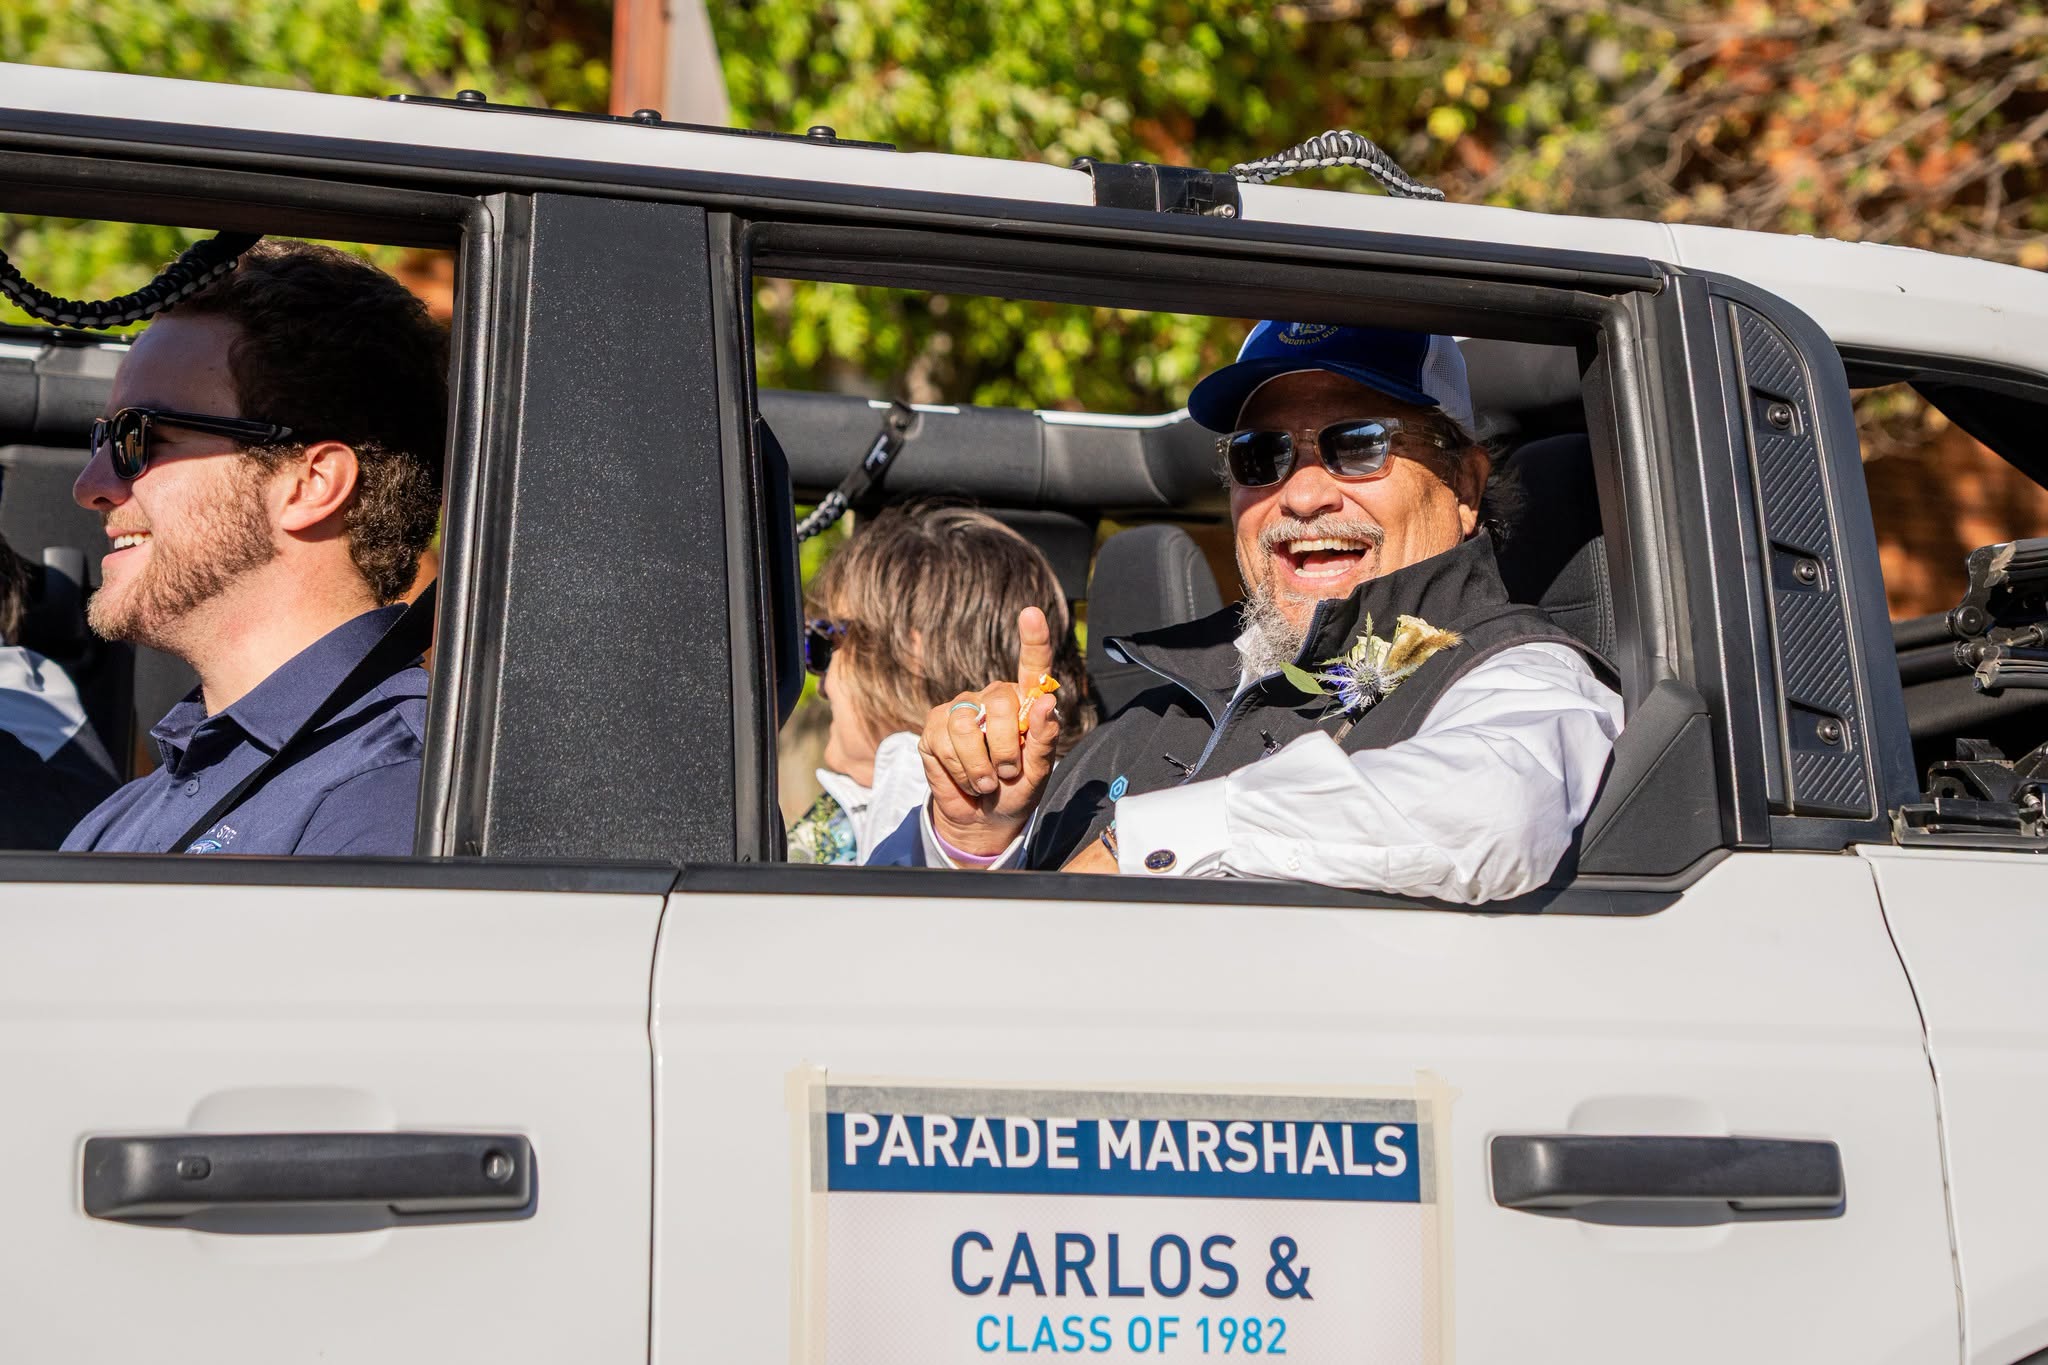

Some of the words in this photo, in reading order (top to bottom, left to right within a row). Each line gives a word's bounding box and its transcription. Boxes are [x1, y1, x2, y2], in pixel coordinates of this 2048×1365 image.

[844, 1112, 1079, 1169] PARADE
[1098, 1118, 1408, 1177] MARSHALS
[951, 1230, 1240, 1299] CARLOS
[1265, 1235, 1314, 1301] &
[975, 1314, 1113, 1354] CLASS
[1127, 1315, 1180, 1354] OF
[1195, 1316, 1288, 1355] 1982
